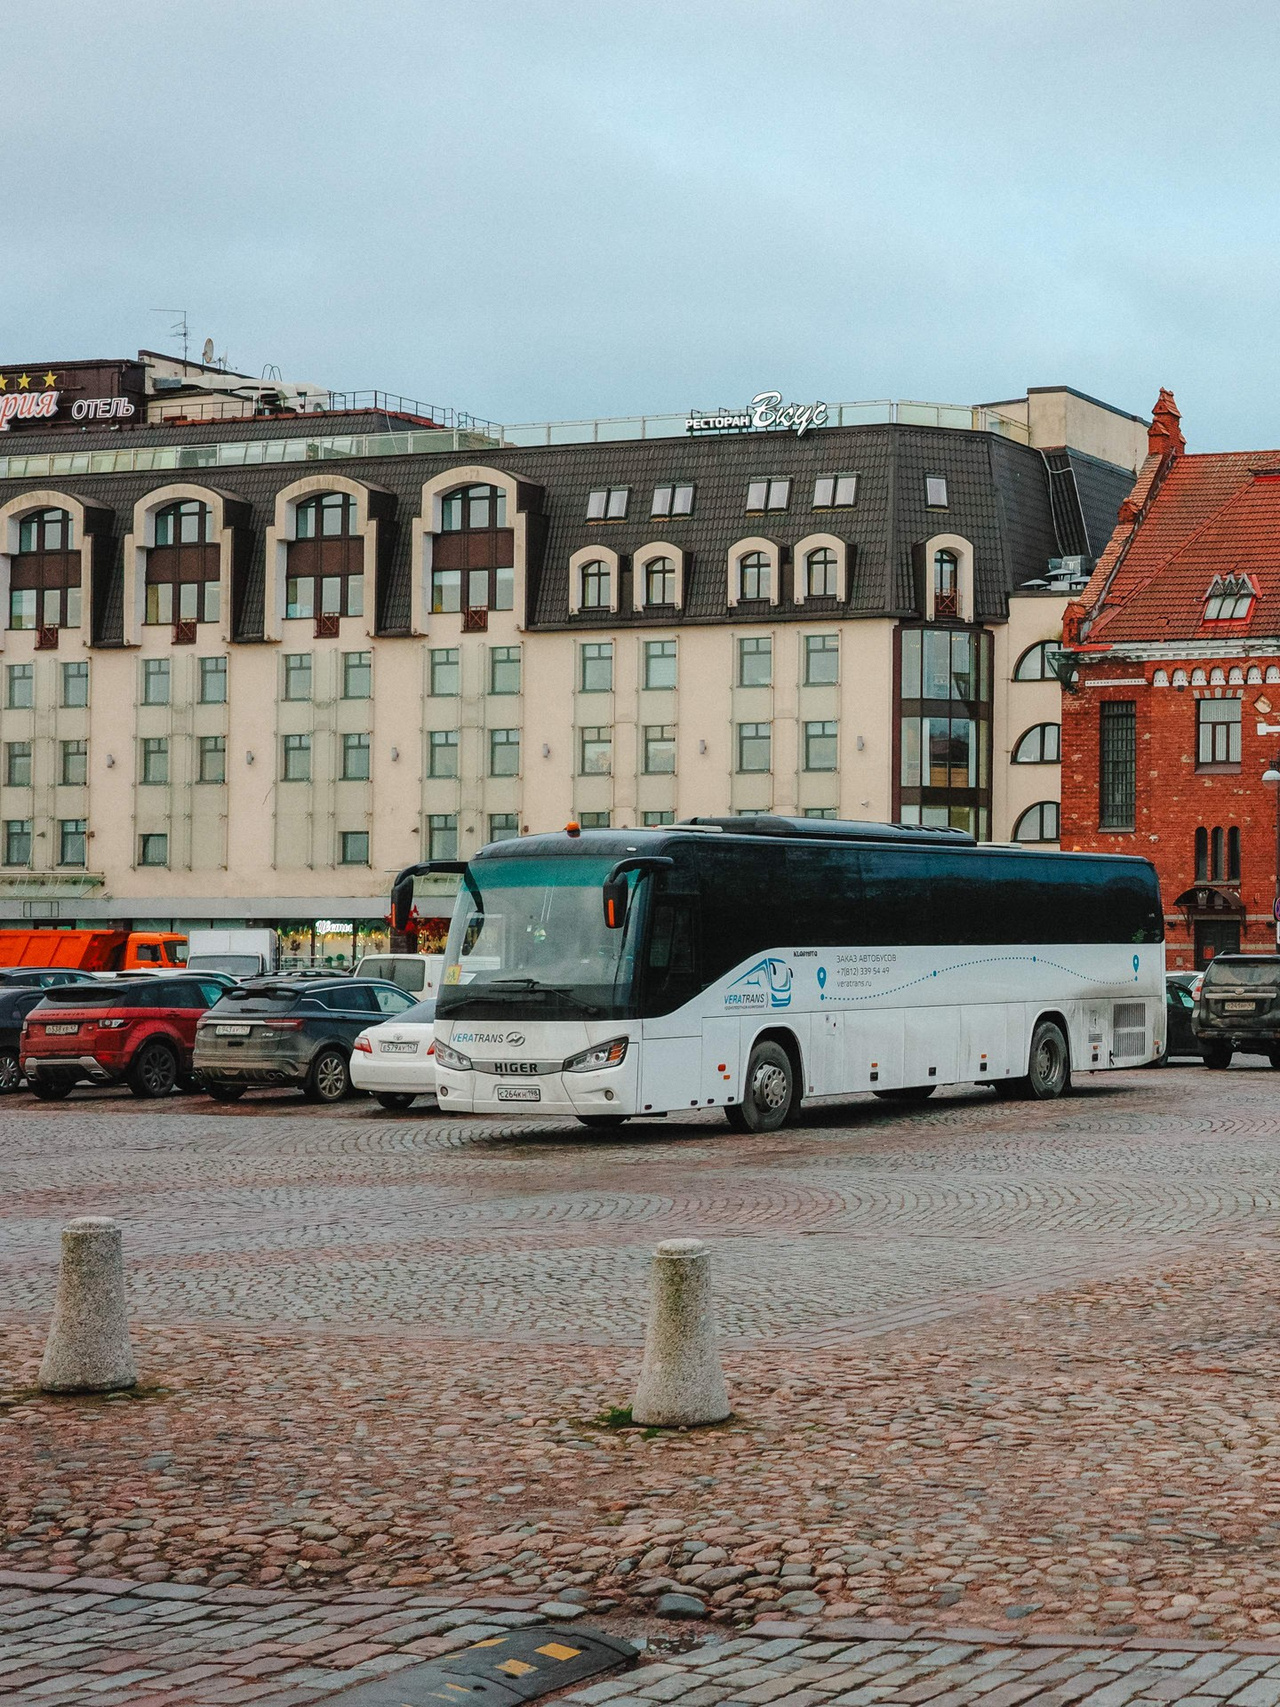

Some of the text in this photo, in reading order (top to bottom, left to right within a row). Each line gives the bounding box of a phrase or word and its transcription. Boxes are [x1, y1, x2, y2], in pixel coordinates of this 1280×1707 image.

[72, 398, 134, 419] ОТЕЛЬ
[685, 391, 828, 437] РЕСТОРАН Вкус
[836, 954, 897, 963] ЗАКАЗ АВТОБУСОВ
[860, 967, 871, 975] 339
[724, 993, 765, 1004] VERATRANS
[452, 1033, 504, 1043] VERATRANS
[494, 1063, 538, 1073] HIGER
